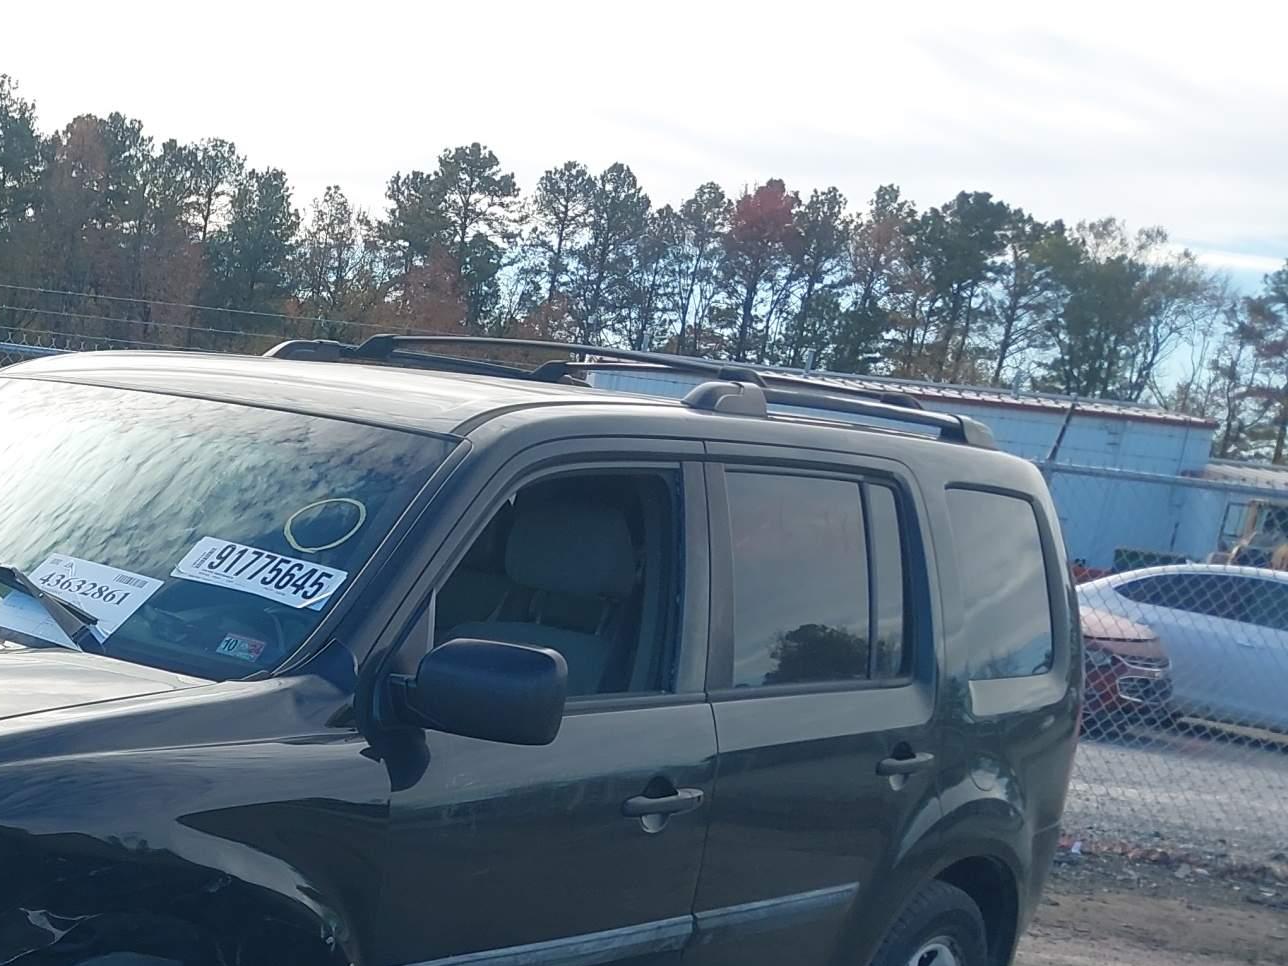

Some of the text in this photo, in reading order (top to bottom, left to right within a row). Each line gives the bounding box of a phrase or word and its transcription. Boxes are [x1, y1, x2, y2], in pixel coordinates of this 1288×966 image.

[39, 571, 131, 606] 43632861
[207, 544, 333, 600] 91775645
[222, 638, 239, 651] 10
